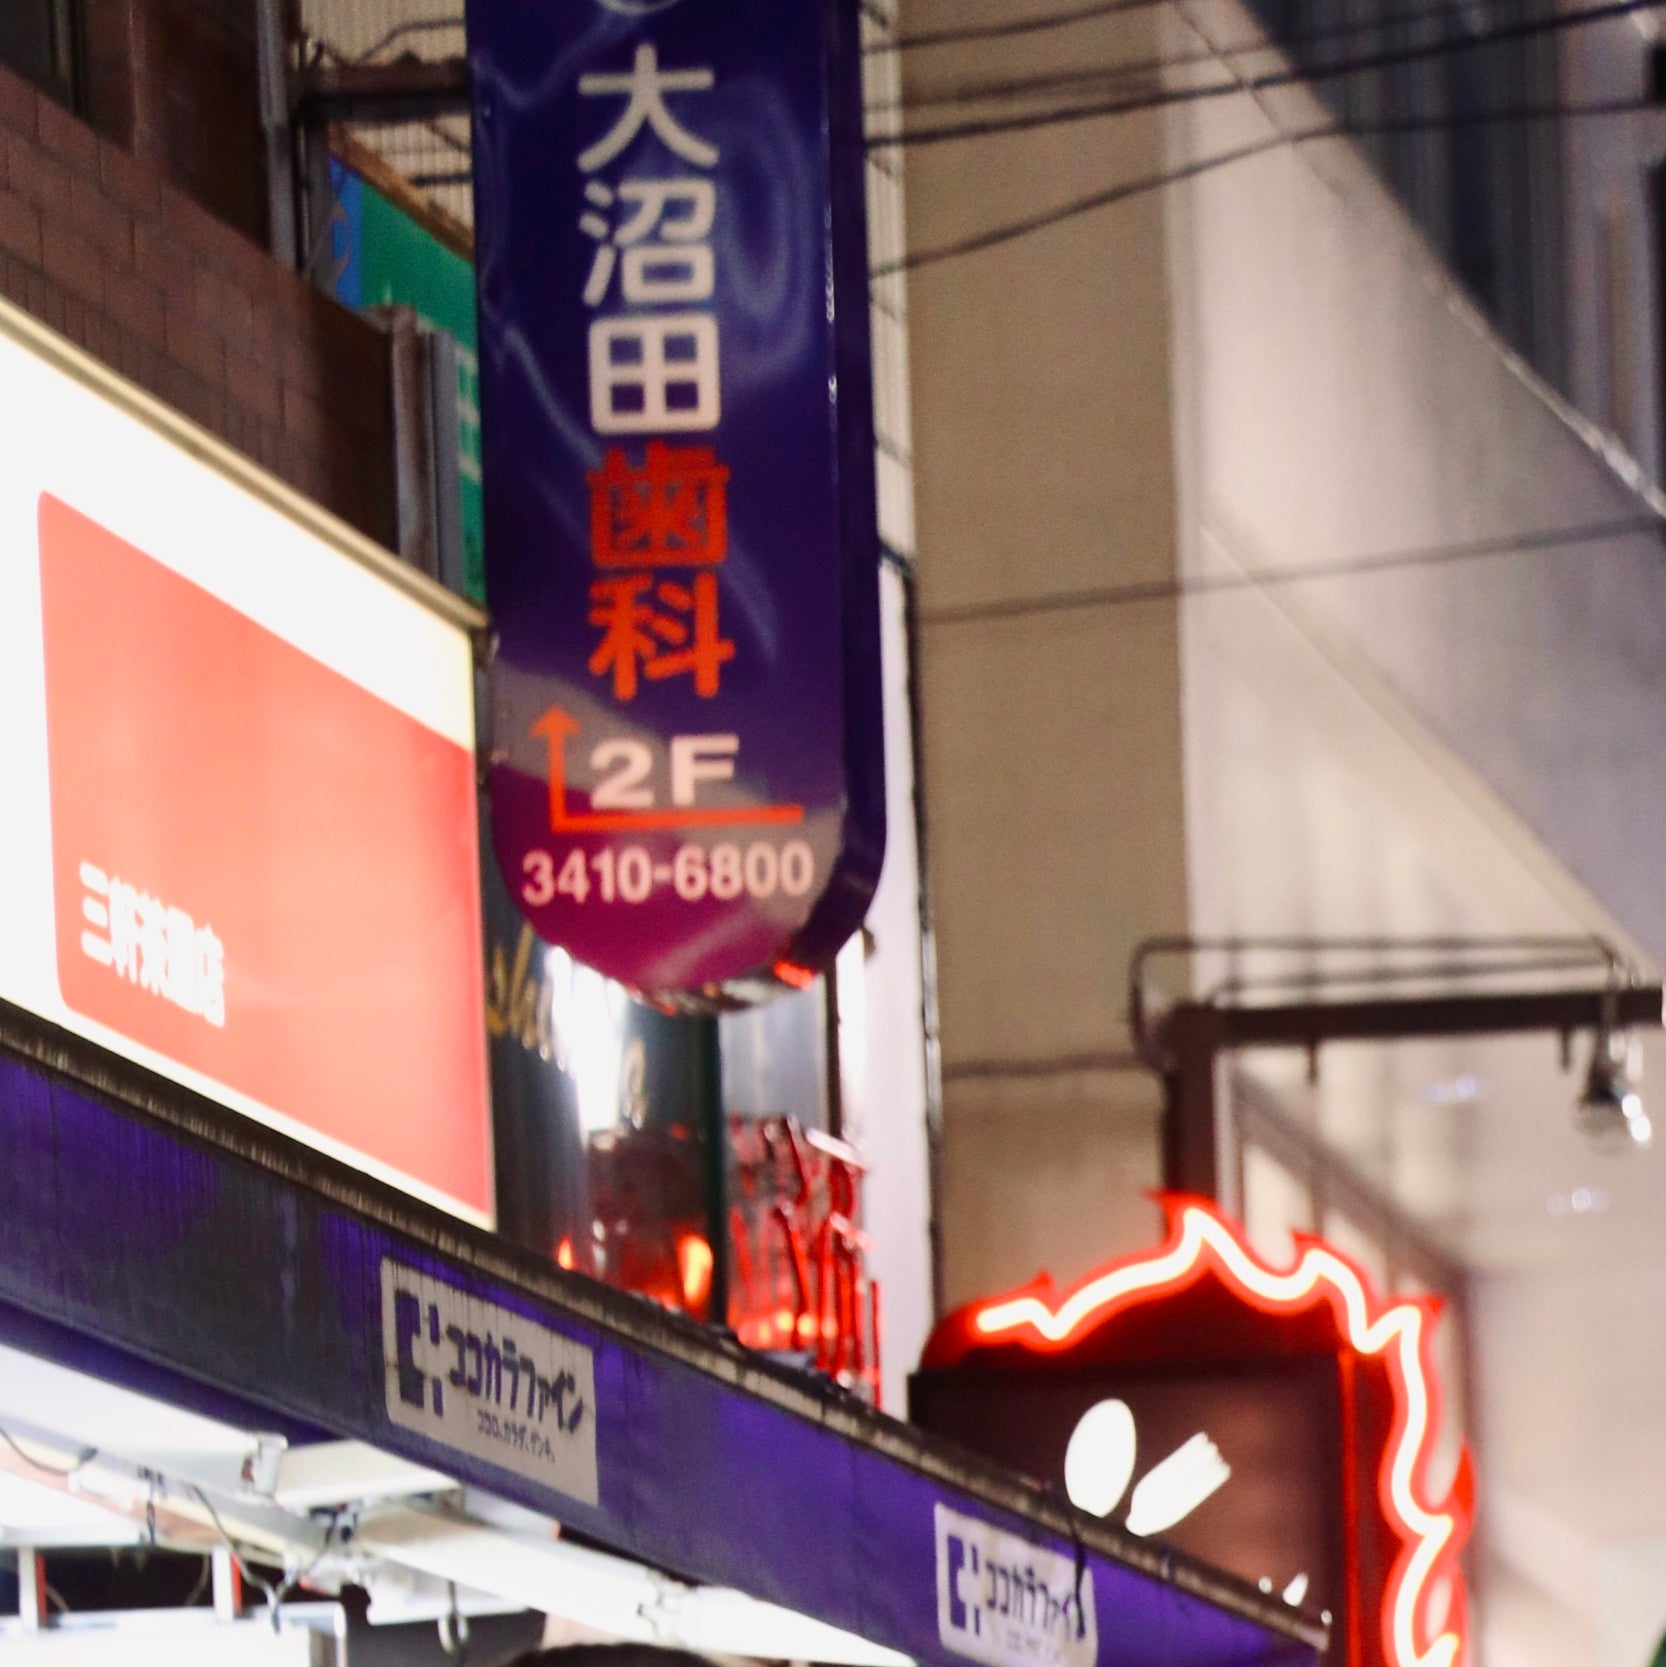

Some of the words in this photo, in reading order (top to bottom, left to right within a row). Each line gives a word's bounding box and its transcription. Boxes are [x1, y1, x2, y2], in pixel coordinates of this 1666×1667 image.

[576, 43, 736, 700] 大沼田歯科
[590, 732, 740, 809] 2F
[522, 841, 815, 907] 3410-6800
